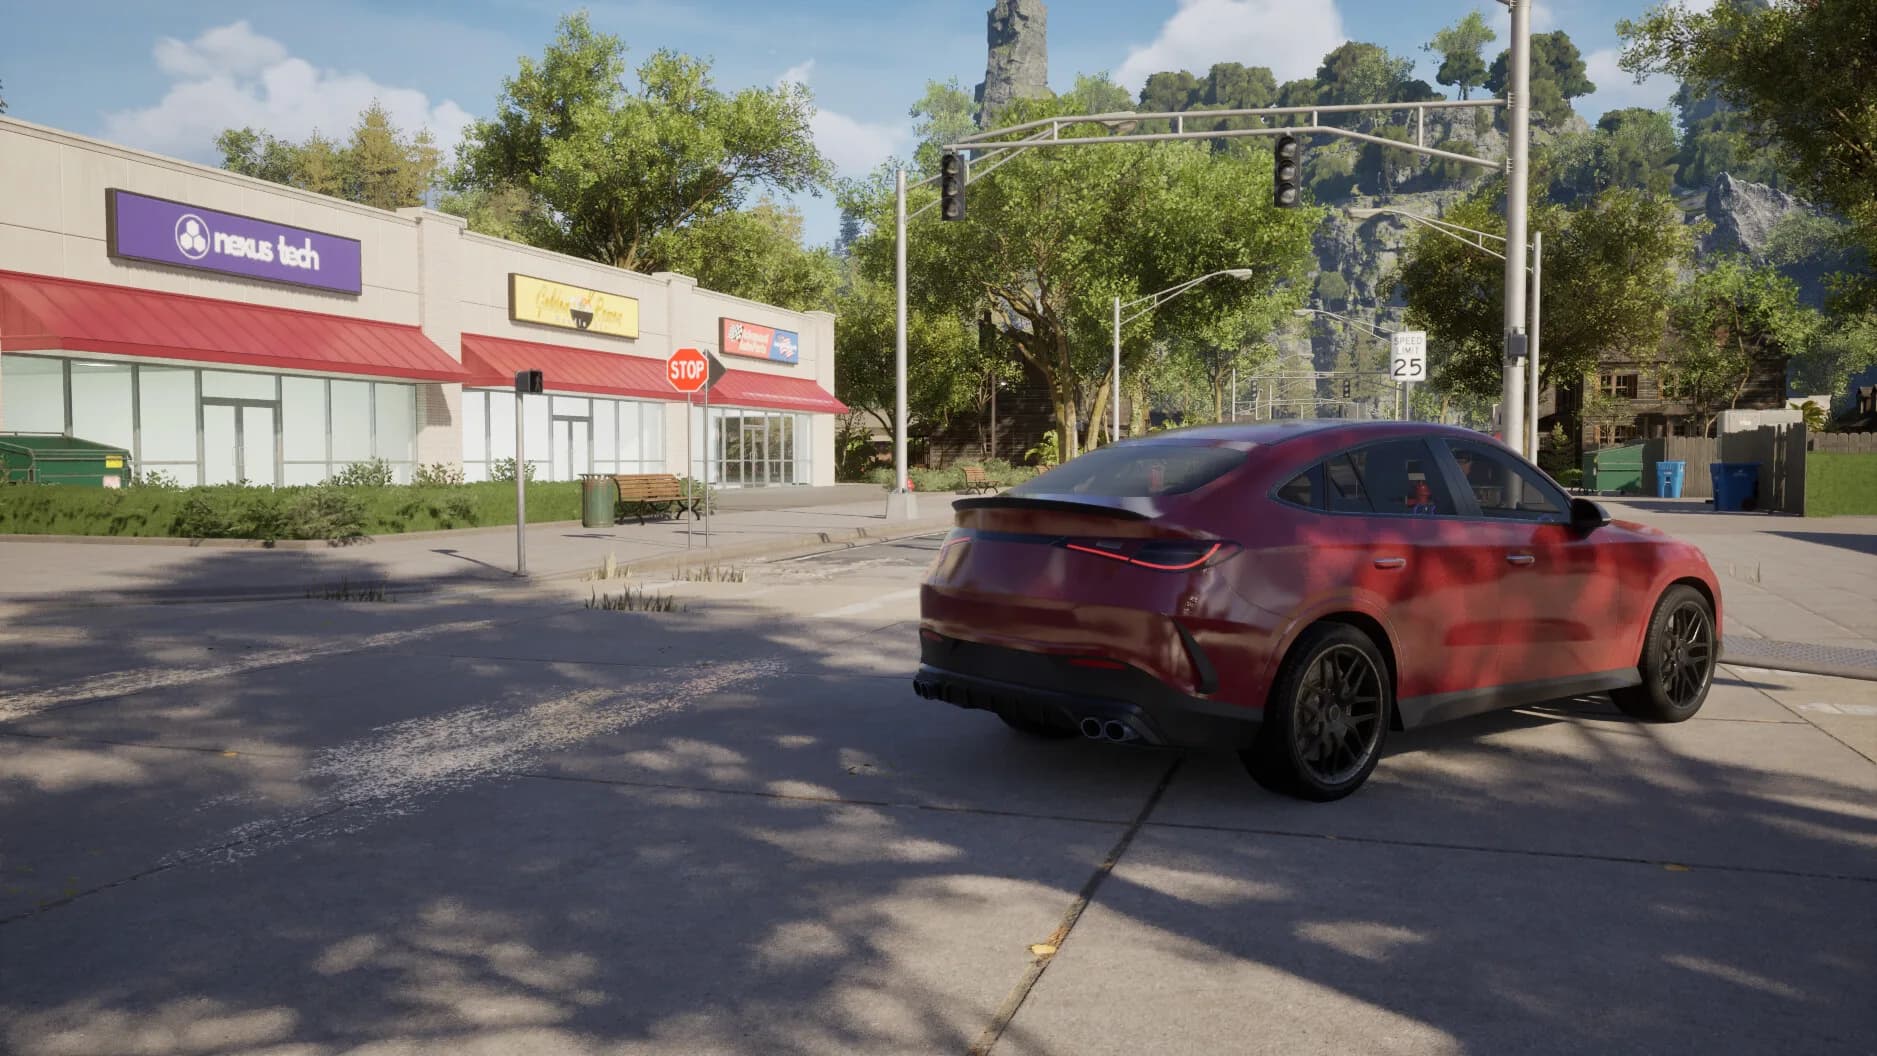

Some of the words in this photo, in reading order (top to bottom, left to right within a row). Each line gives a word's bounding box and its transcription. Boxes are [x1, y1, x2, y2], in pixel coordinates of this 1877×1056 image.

[214, 231, 274, 262] nexus
[277, 235, 320, 270] tech
[1393, 336, 1422, 346] SPEED
[1396, 346, 1420, 355] LIMIT
[671, 360, 705, 379] STOP
[1394, 358, 1422, 376] 25
